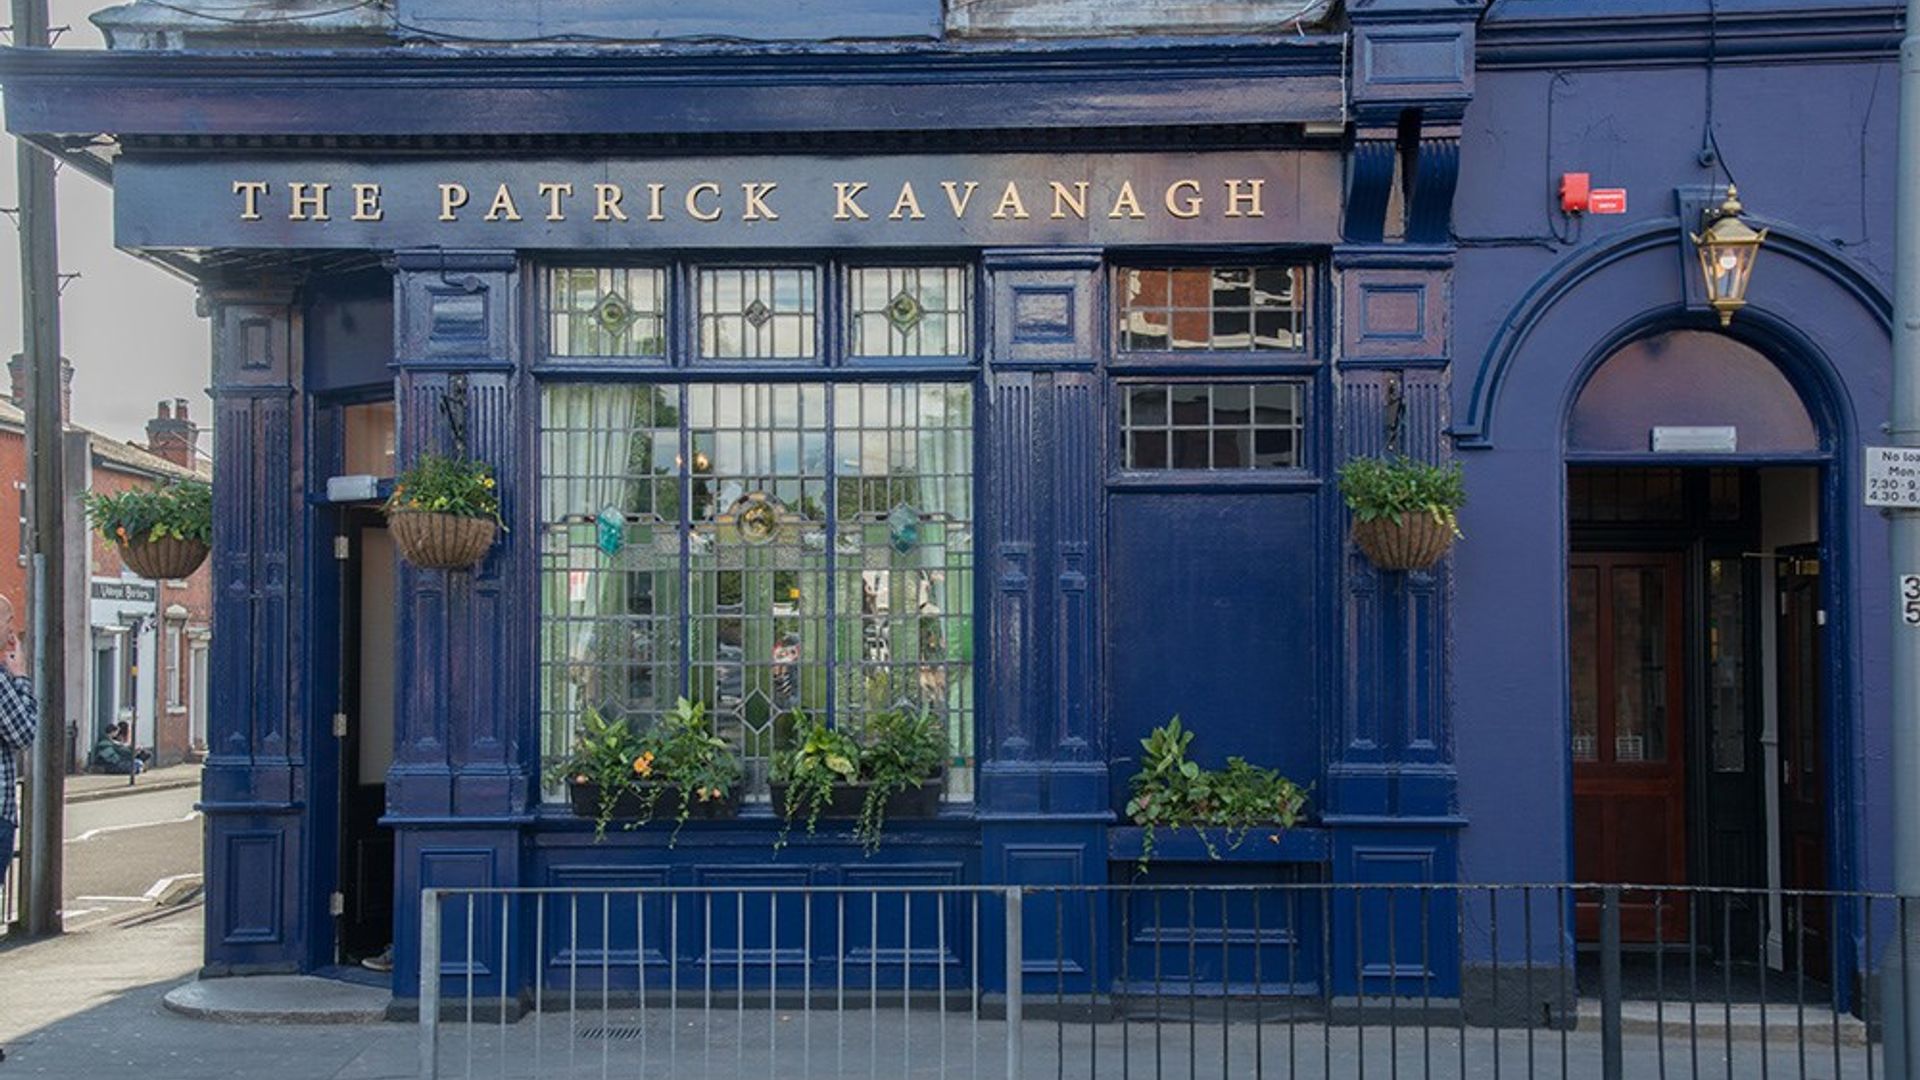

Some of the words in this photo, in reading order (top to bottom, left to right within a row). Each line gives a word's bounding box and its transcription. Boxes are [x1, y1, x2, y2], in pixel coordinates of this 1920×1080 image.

[233, 180, 384, 221] THE
[438, 181, 780, 222] PATRICK
[832, 179, 1266, 220] KAVANAGH
[1881, 451, 1900, 461] No
[1888, 466, 1915, 477] Mon
[1870, 478, 1899, 490] 7.30
[1869, 491, 1900, 502] 4.30
